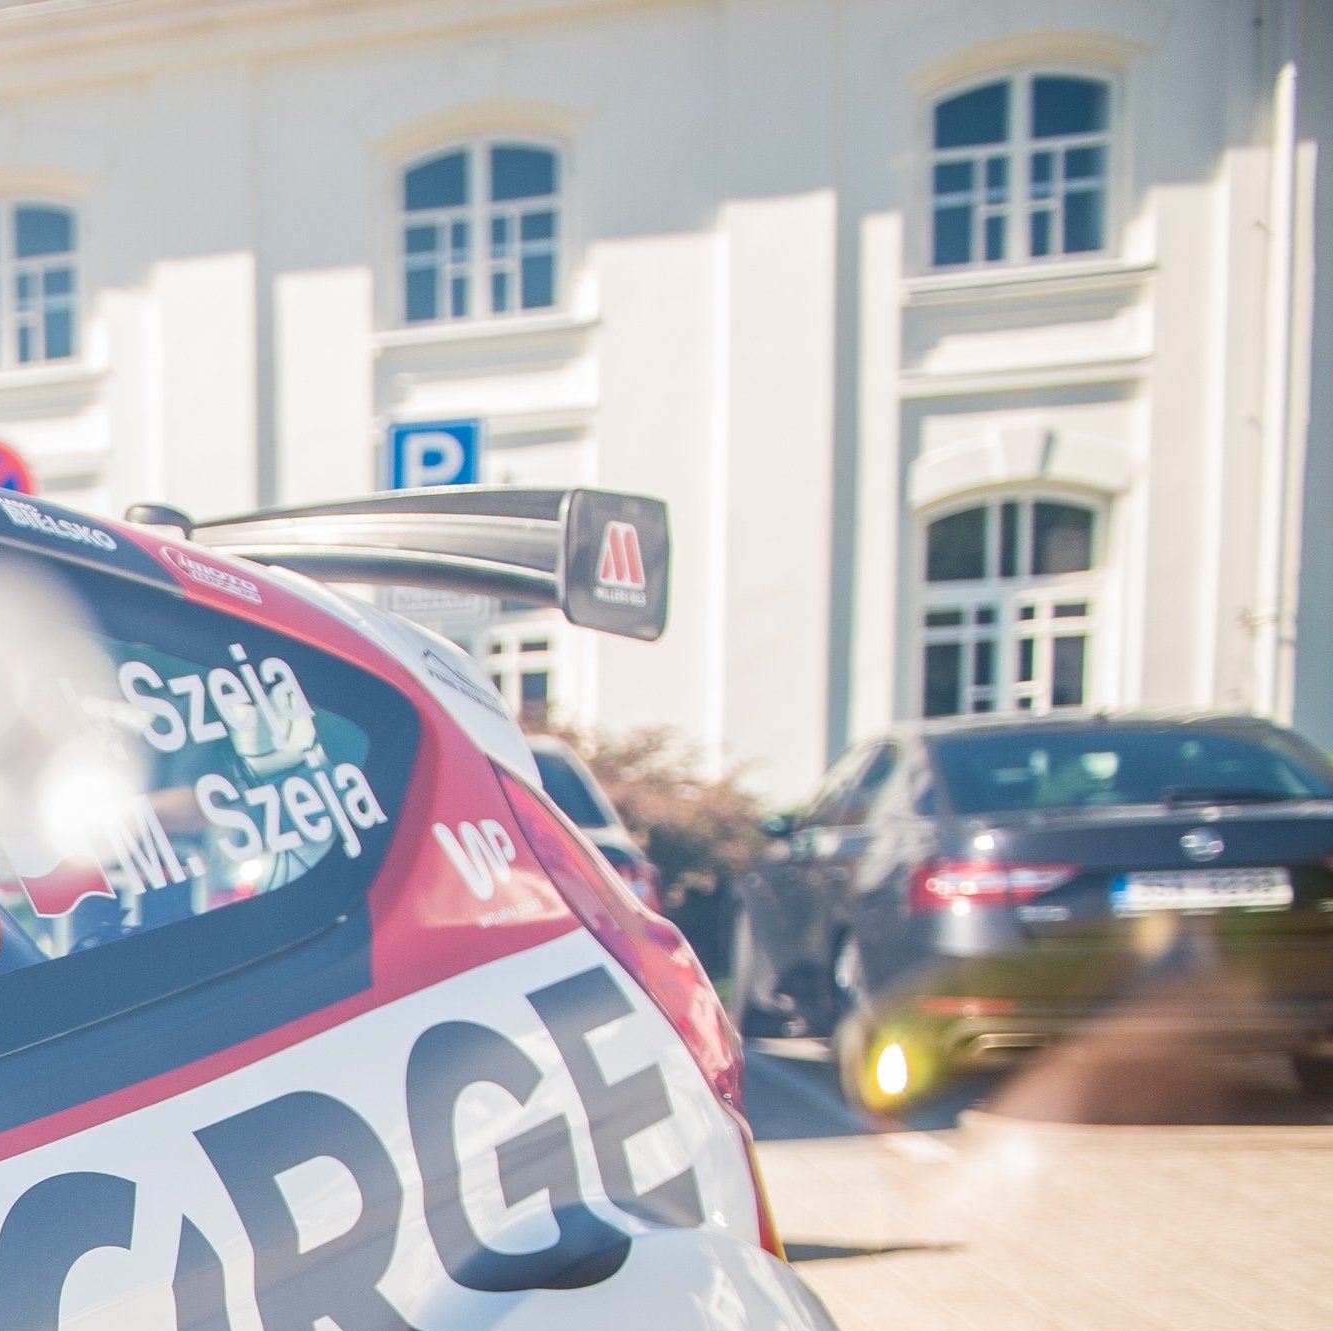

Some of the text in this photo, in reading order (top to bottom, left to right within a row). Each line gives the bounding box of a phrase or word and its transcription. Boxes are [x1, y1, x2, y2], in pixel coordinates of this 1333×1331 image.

[401, 430, 465, 488] P
[3, 505, 118, 551] BIELSKO
[118, 643, 318, 753] Szeja
[196, 742, 389, 859] Szeja
